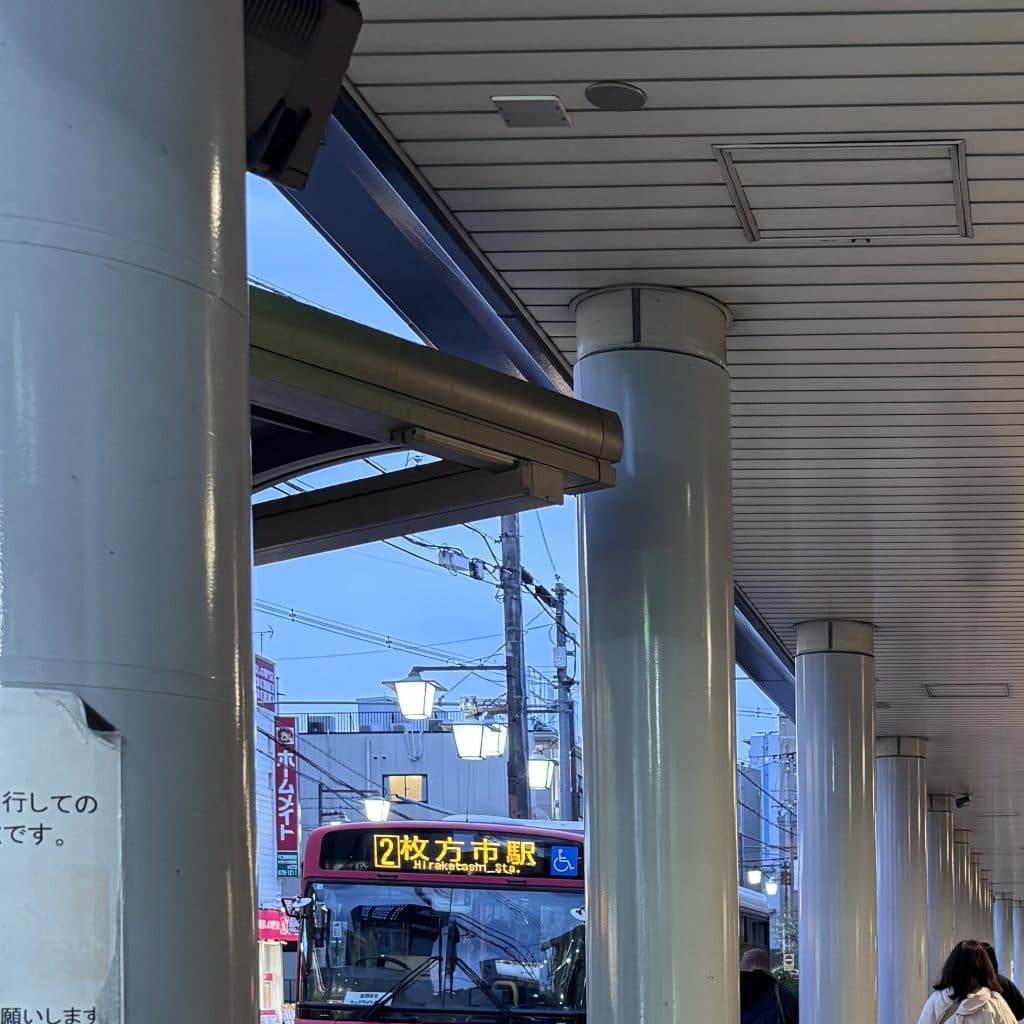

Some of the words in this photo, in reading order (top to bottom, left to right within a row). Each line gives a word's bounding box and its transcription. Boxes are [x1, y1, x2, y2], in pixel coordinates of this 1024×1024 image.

[2, 791, 98, 814] 行しての
[276, 750, 295, 842] ホームメイト
[0, 822, 65, 847] です。
[400, 834, 537, 867] 枚方市駅
